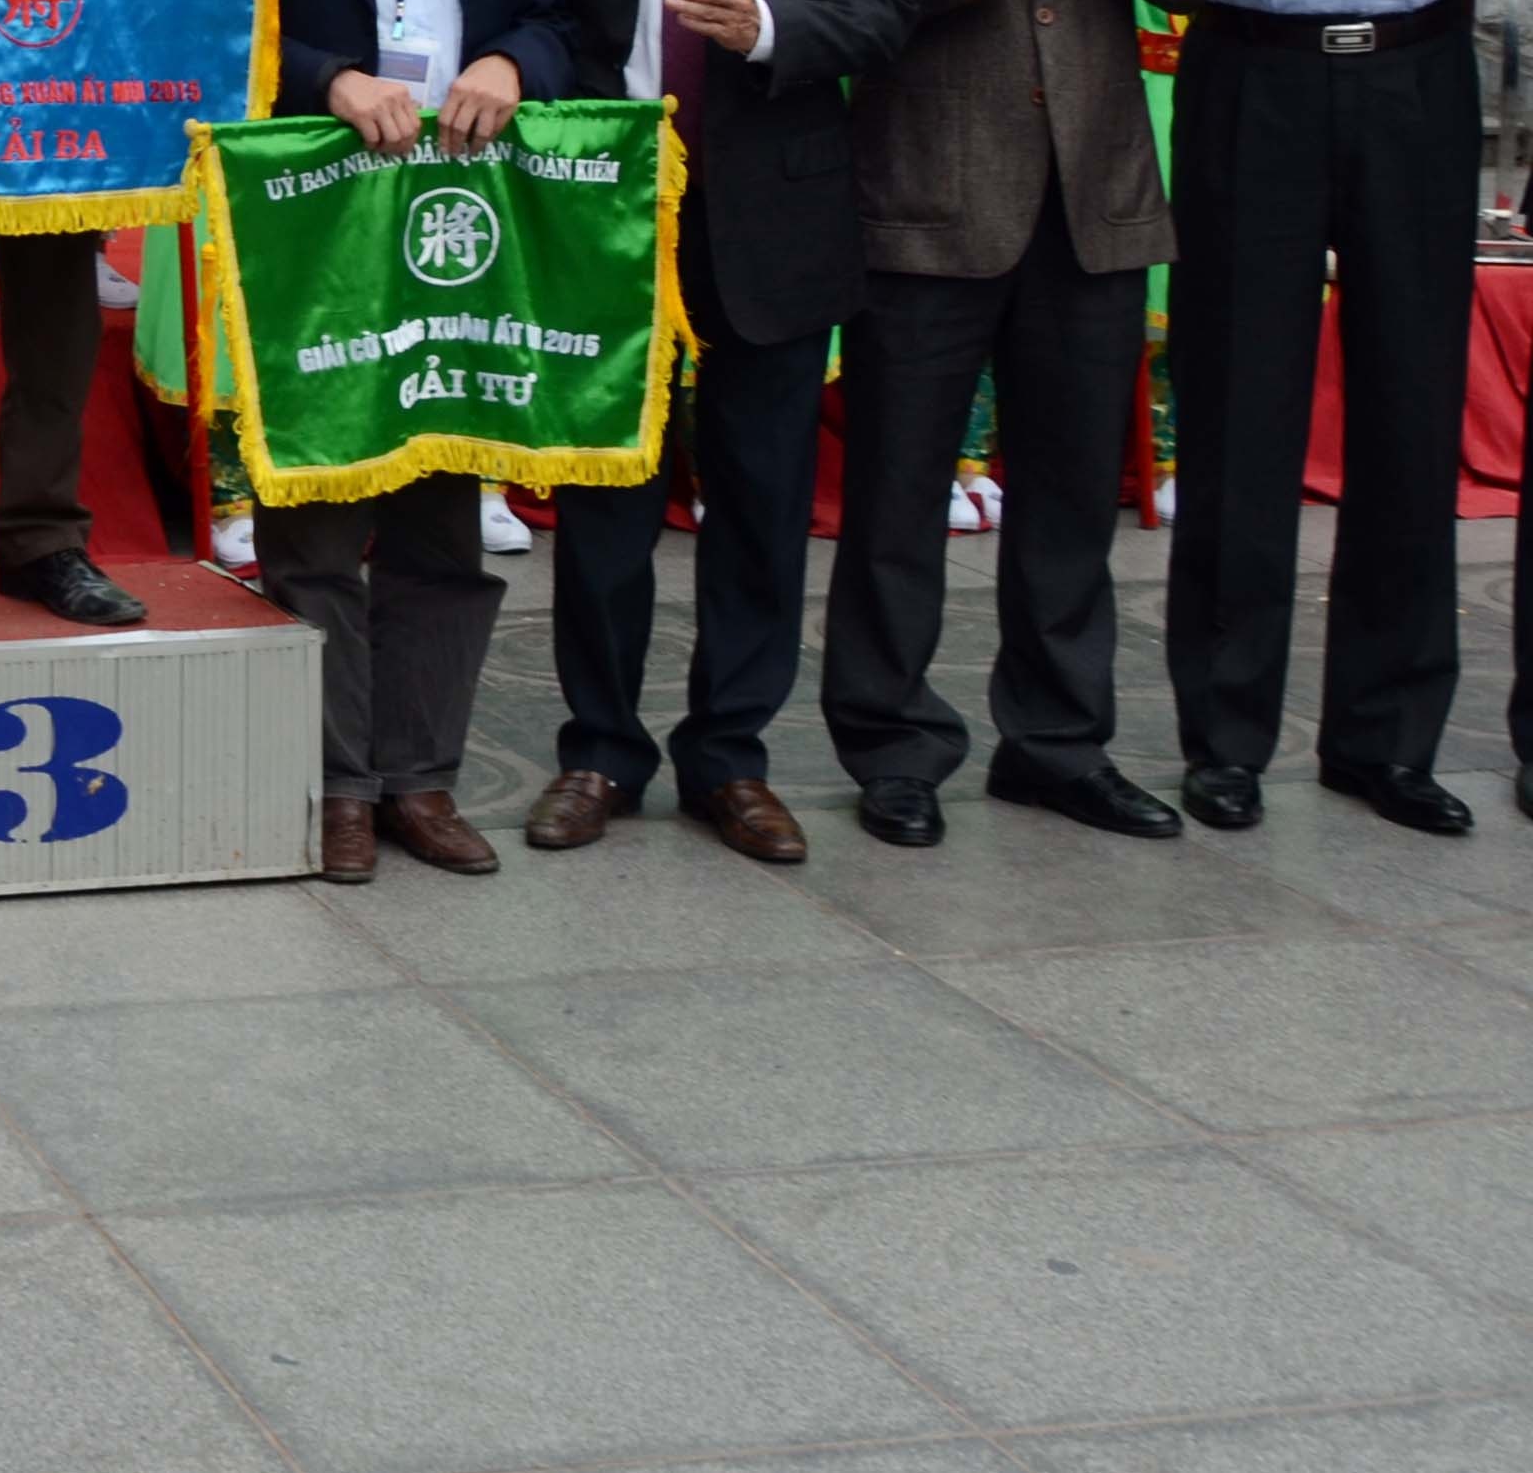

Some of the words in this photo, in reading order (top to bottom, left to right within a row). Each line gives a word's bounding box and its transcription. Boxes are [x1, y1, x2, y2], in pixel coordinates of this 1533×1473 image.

[150, 80, 201, 104] 2015
[55, 130, 107, 160] BA
[299, 162, 340, 193] BAN
[417, 201, 489, 270] 將
[297, 334, 346, 373] GIẢI
[542, 329, 601, 357] 2015
[476, 372, 538, 406] TƯ
